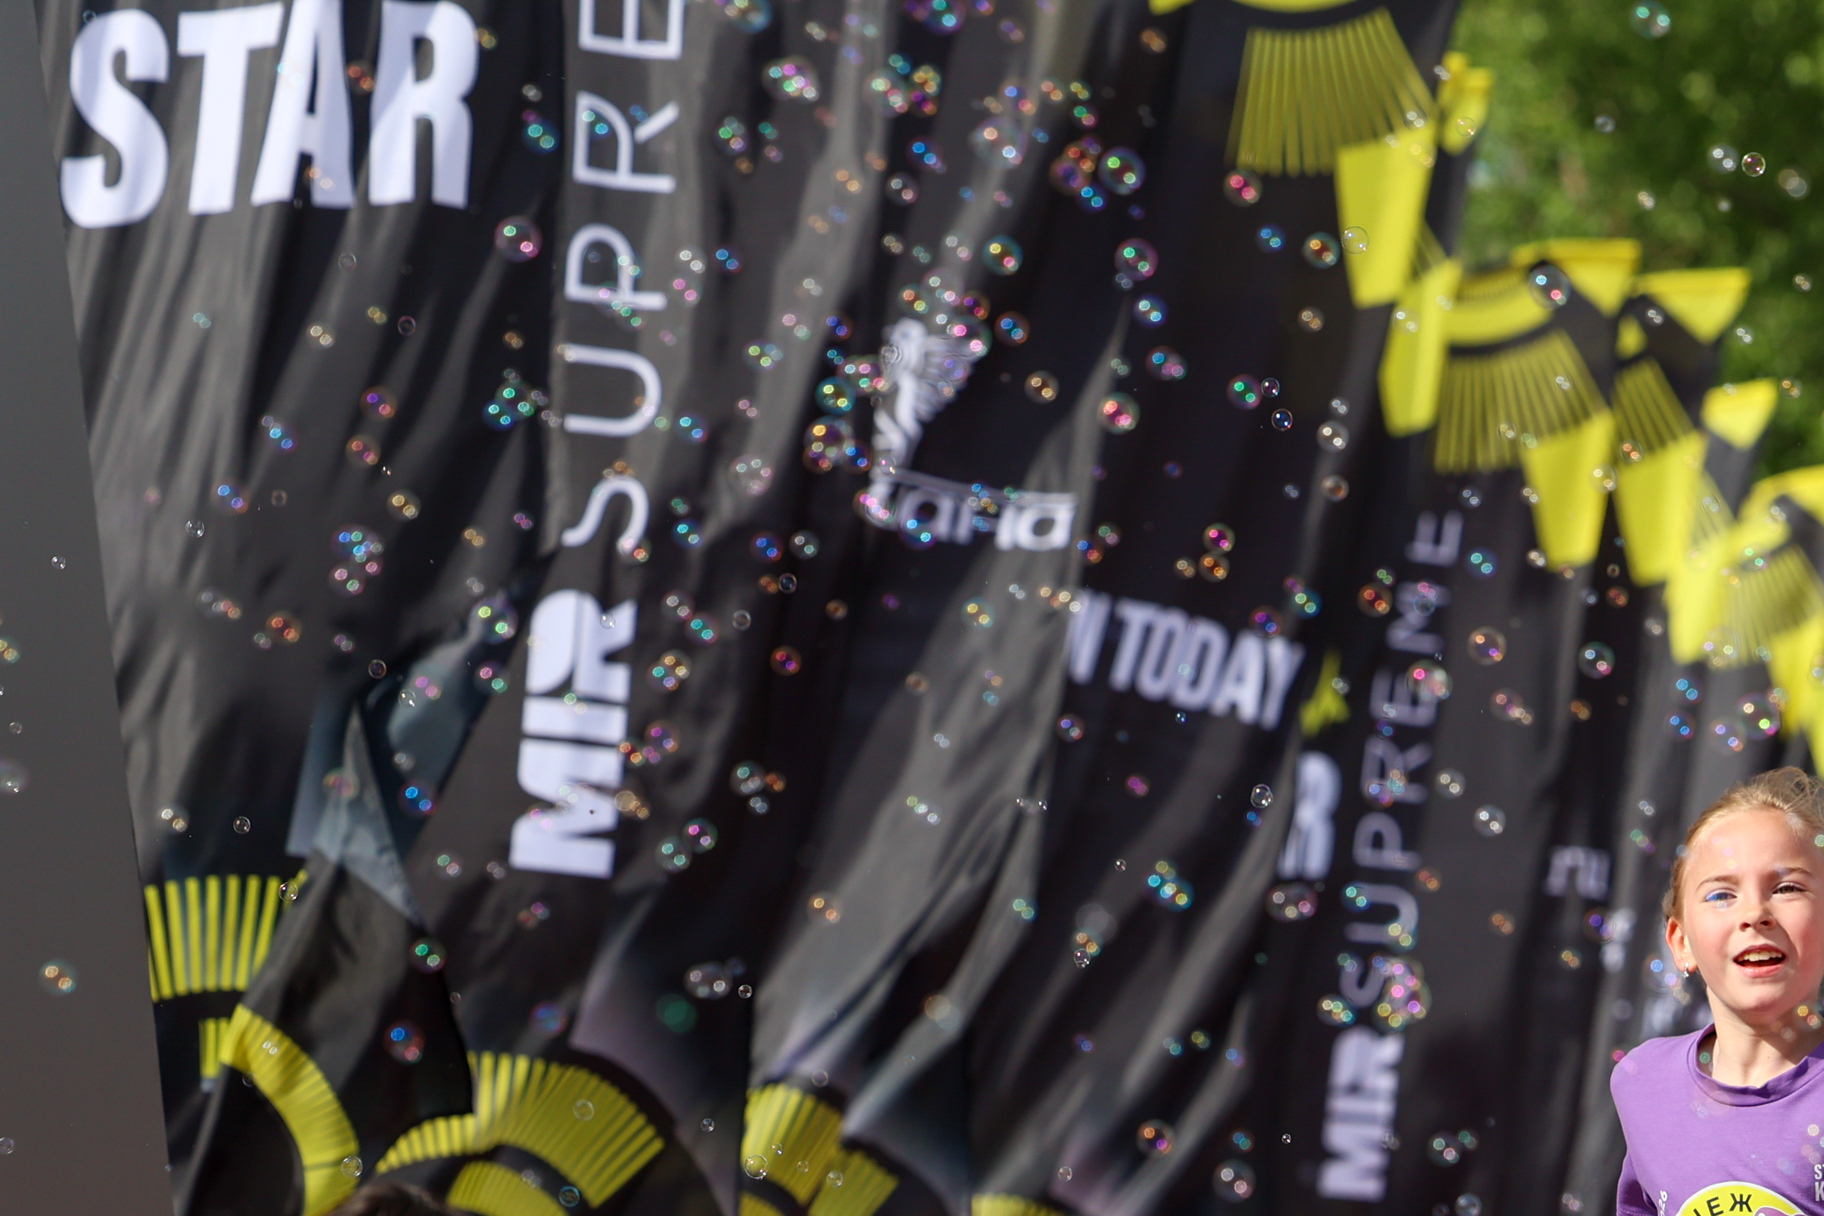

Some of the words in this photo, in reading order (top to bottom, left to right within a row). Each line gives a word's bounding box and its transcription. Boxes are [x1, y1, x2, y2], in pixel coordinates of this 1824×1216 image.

[61, 0, 481, 229] STAR
[509, 588, 639, 879] MIR
[1109, 596, 1306, 731] TODAY
